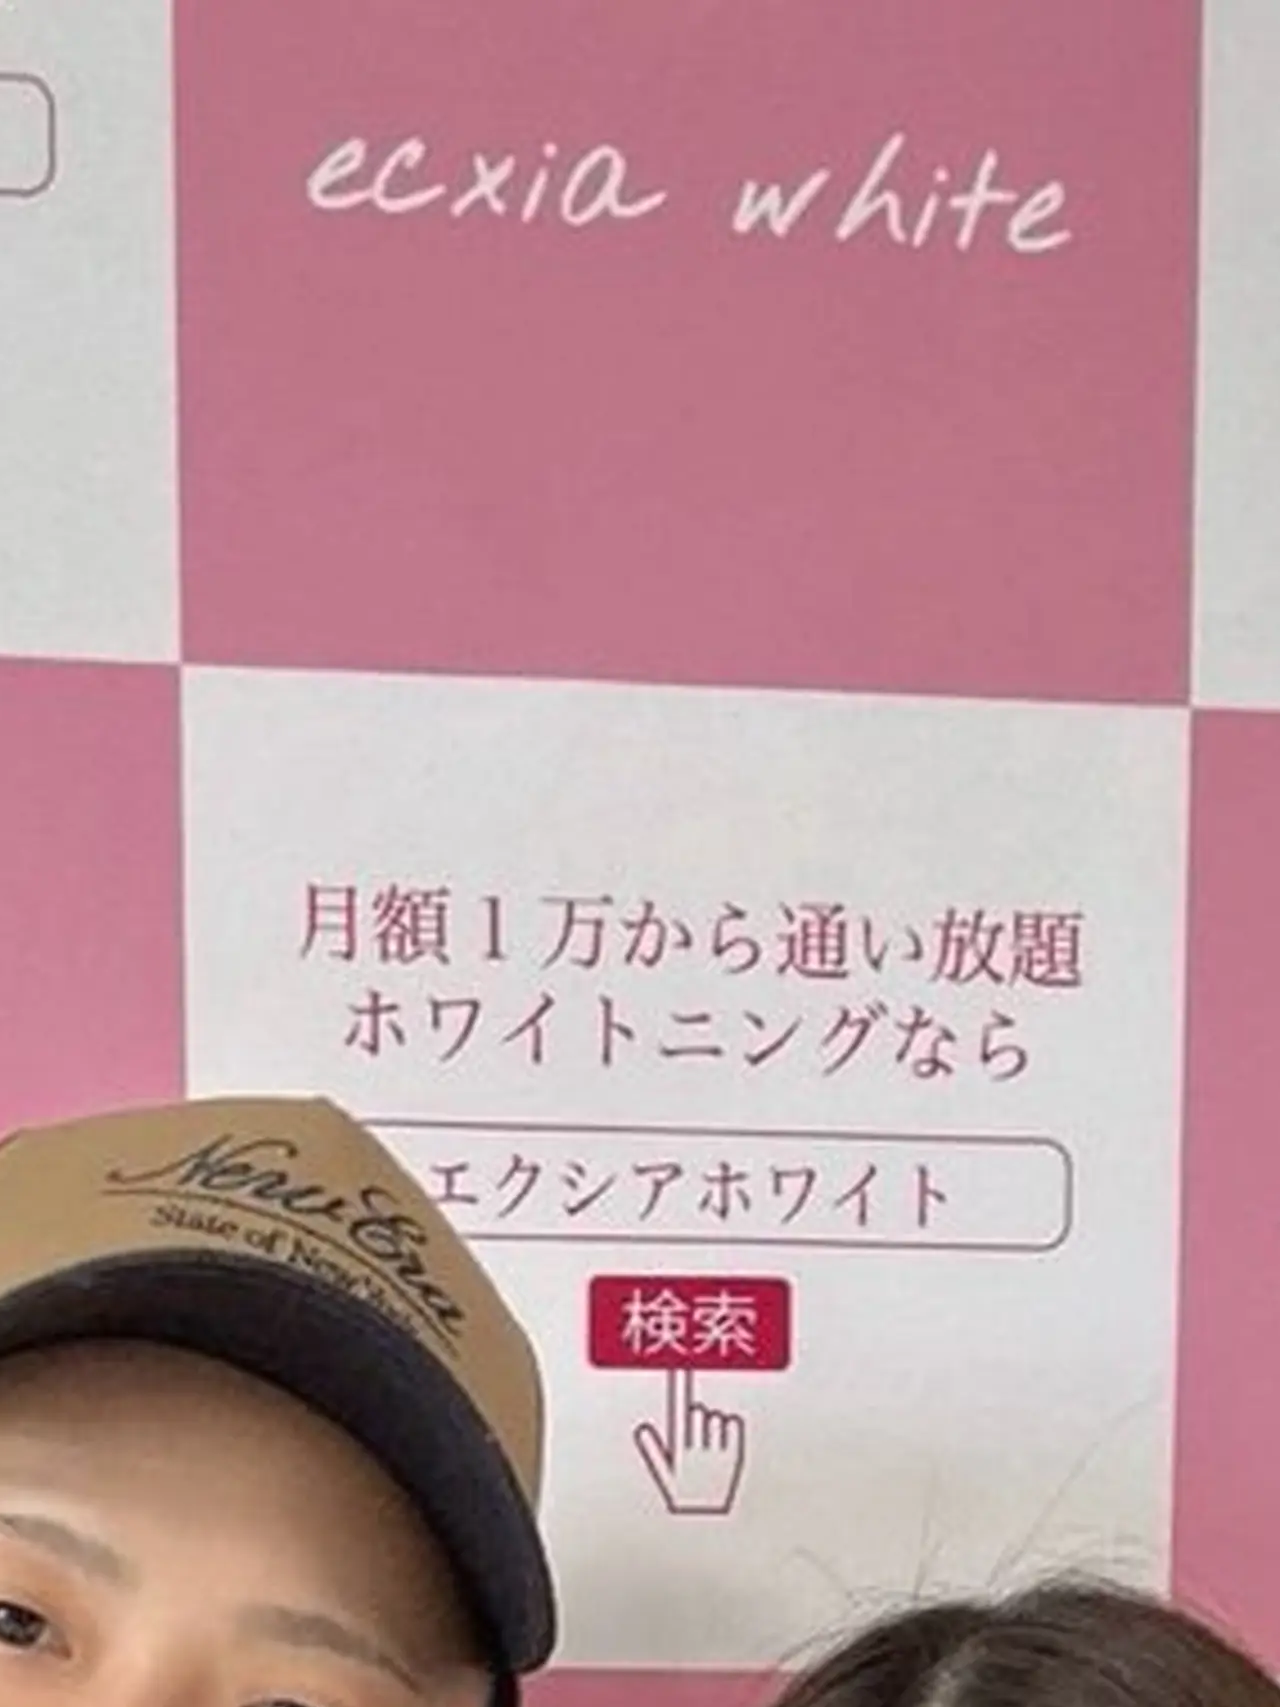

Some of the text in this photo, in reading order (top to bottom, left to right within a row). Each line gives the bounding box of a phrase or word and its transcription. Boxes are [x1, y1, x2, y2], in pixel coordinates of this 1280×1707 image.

[306, 133, 1074, 254] ecxia white
[344, 993, 1030, 1081] ホワイトニングなら
[432, 1155, 949, 1228] エクシアホワイト
[150, 1203, 239, 1240] State
[243, 1226, 287, 1256] of
[621, 1292, 759, 1357] 検索
